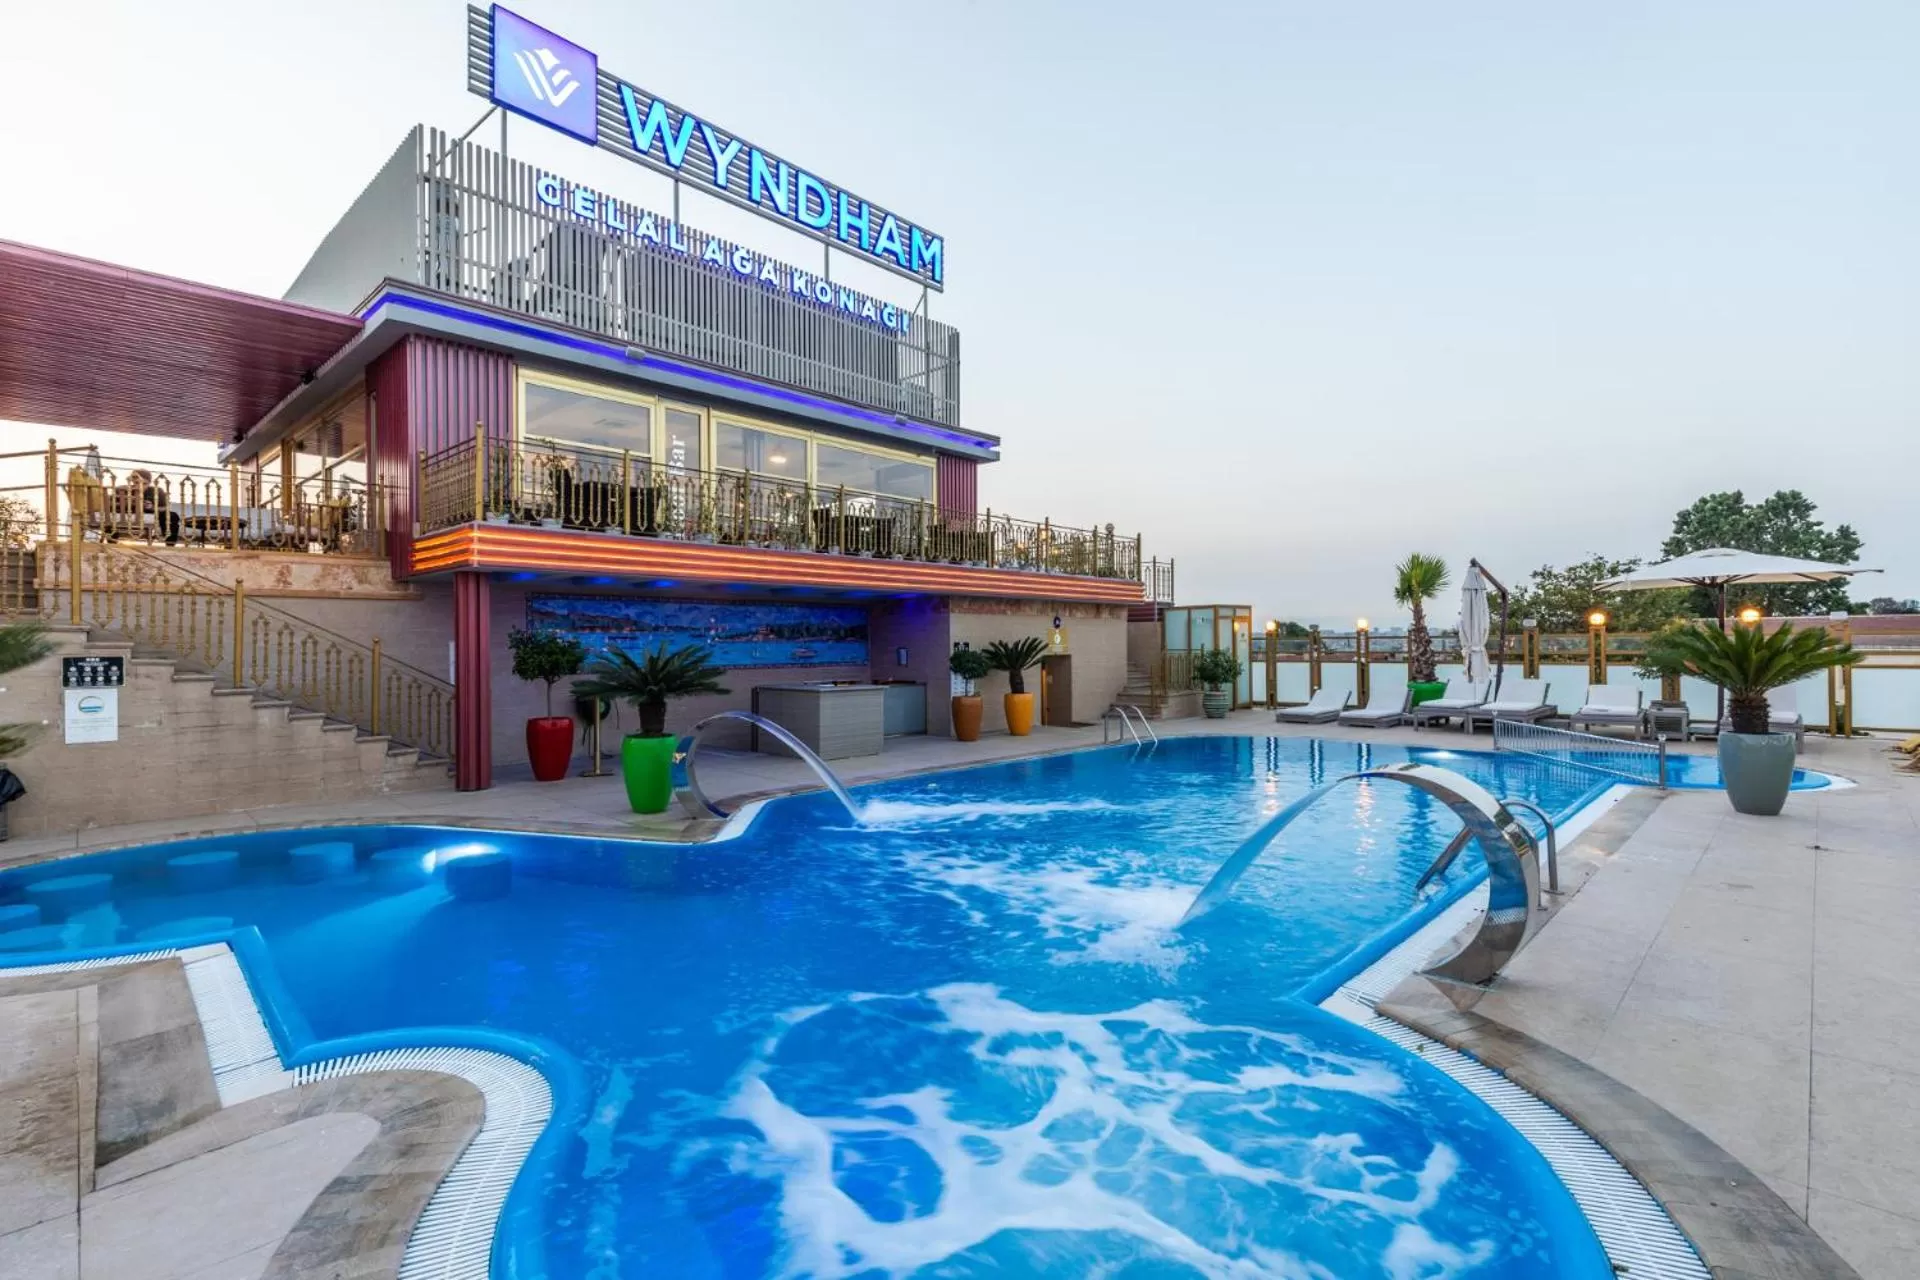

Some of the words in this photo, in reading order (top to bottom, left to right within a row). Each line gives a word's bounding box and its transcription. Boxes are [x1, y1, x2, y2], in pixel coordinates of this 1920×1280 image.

[537, 177, 688, 253] CELAL
[617, 81, 943, 282] WYNDHAM
[667, 433, 685, 476] Bar
